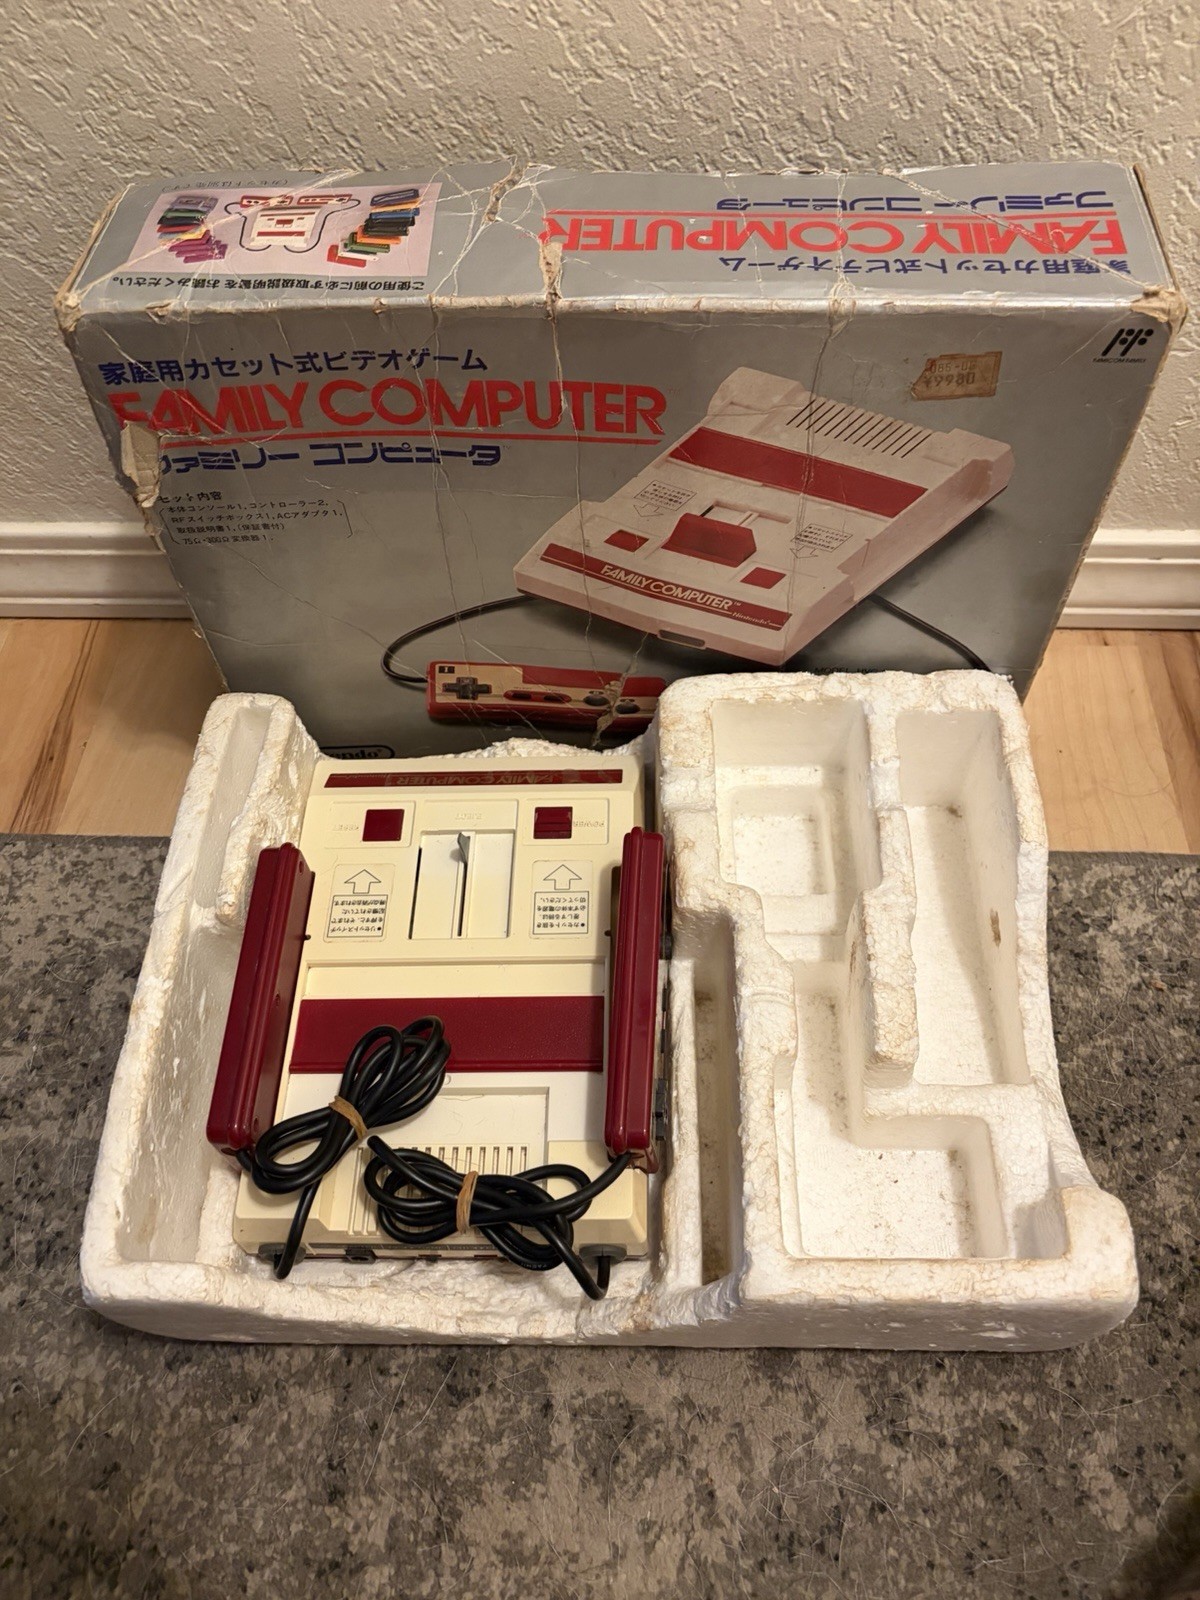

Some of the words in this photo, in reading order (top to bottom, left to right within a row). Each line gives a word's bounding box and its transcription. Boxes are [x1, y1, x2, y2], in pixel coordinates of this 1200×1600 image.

[716, 197, 922, 211] コンピュータ
[934, 190, 1113, 212] ファミリー
[539, 217, 904, 253] COMPUTER
[912, 219, 1128, 255] FAMILY
[719, 256, 1131, 274] 家庭用カセット式ビデオゲーム
[99, 348, 488, 385] 家庭用カセット式ビデオゲーム
[107, 381, 309, 435] FAMILY
[318, 377, 667, 435] COMPUTER
[309, 442, 500, 466] コンピュータ
[600, 564, 652, 588] FAMILY
[650, 581, 734, 611] COMPUTER
